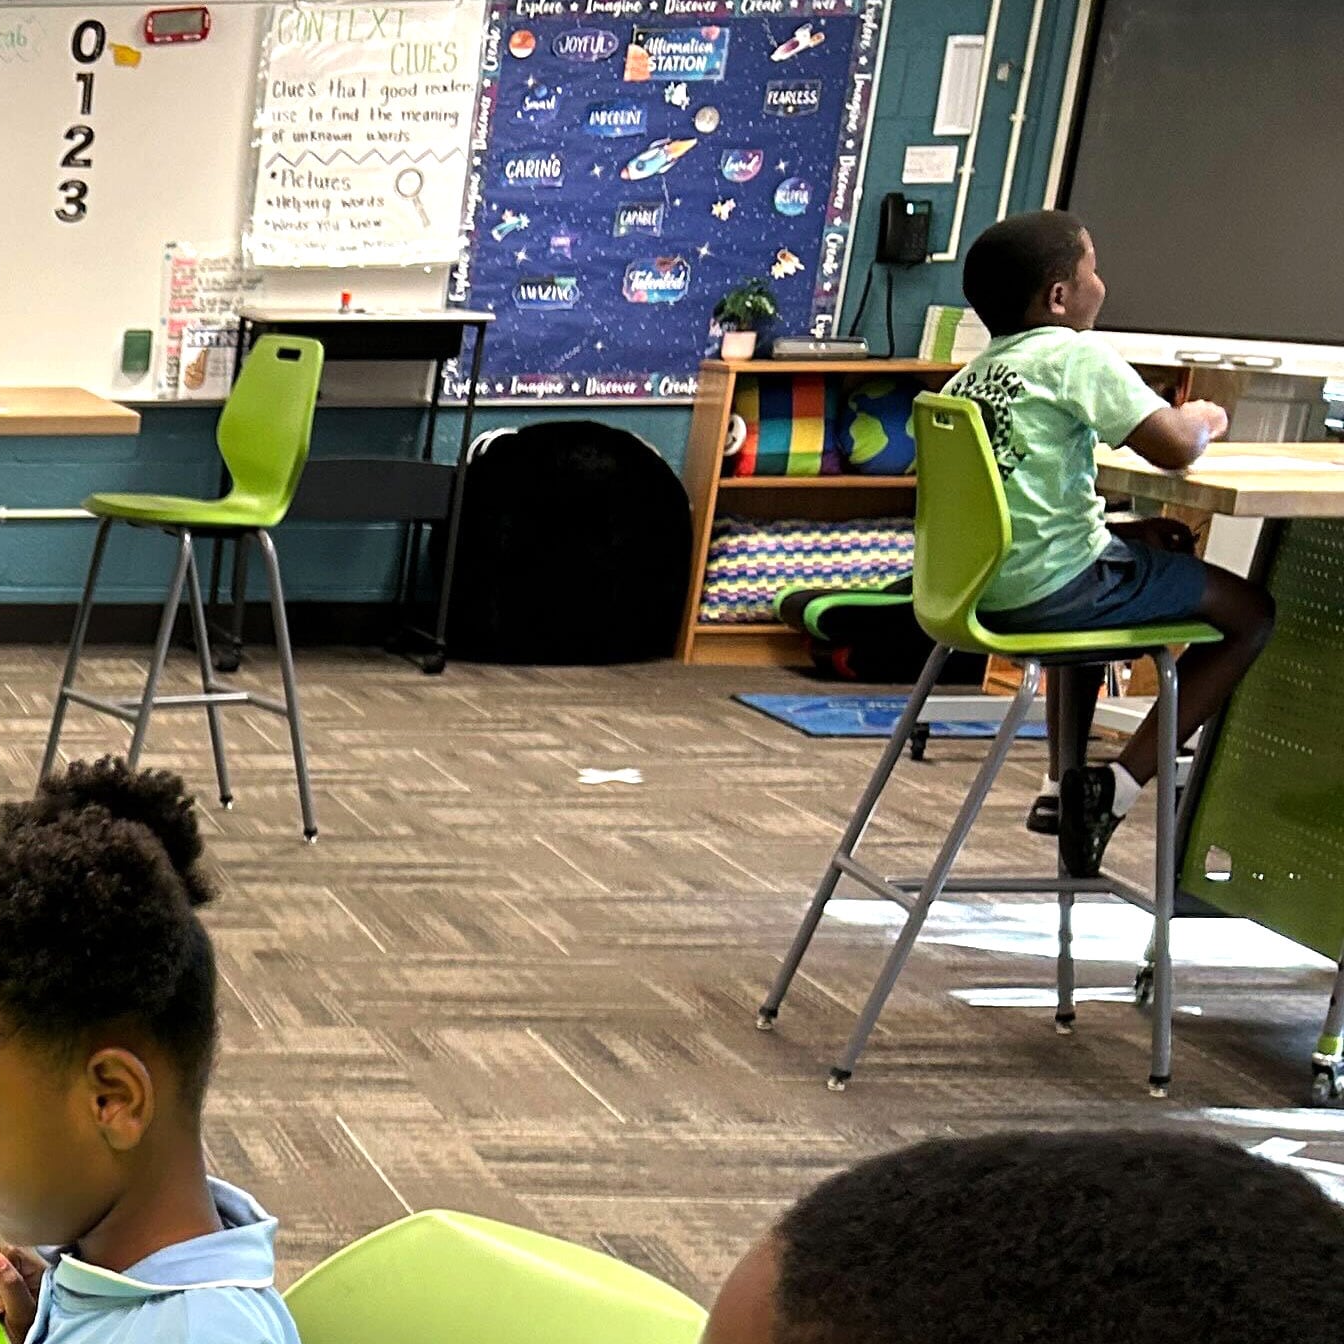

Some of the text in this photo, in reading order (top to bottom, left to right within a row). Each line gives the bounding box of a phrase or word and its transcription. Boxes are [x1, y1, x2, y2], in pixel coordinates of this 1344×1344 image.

[516, 0, 563, 18] Explore
[585, 0, 642, 18] Imagine
[664, 0, 716, 14] Discover
[277, 9, 405, 45] CONTEXT
[71, 19, 107, 64] 0
[558, 35, 608, 52] JOYFUL
[643, 37, 714, 55] Affirmation
[390, 41, 458, 76] CLUES
[647, 56, 707, 72] STATION
[75, 72, 95, 116] 1
[272, 80, 316, 99] Clues
[328, 77, 367, 98] that
[380, 83, 418, 107] good
[767, 89, 818, 106] FEARLESS
[309, 107, 324, 122] to
[331, 106, 360, 122] find
[370, 106, 393, 122] the
[401, 110, 460, 128] meaning
[60, 124, 95, 169] 2
[271, 129, 411, 144] of unknown words
[505, 156, 562, 179] CARING
[281, 169, 352, 192] Pictures
[54, 179, 89, 224] 3
[619, 209, 658, 226] CAPABLE
[629, 268, 687, 291] Talented
[510, 374, 566, 399] Imagine
[585, 375, 637, 396] Discover
[984, 362, 1026, 400] LUCK
